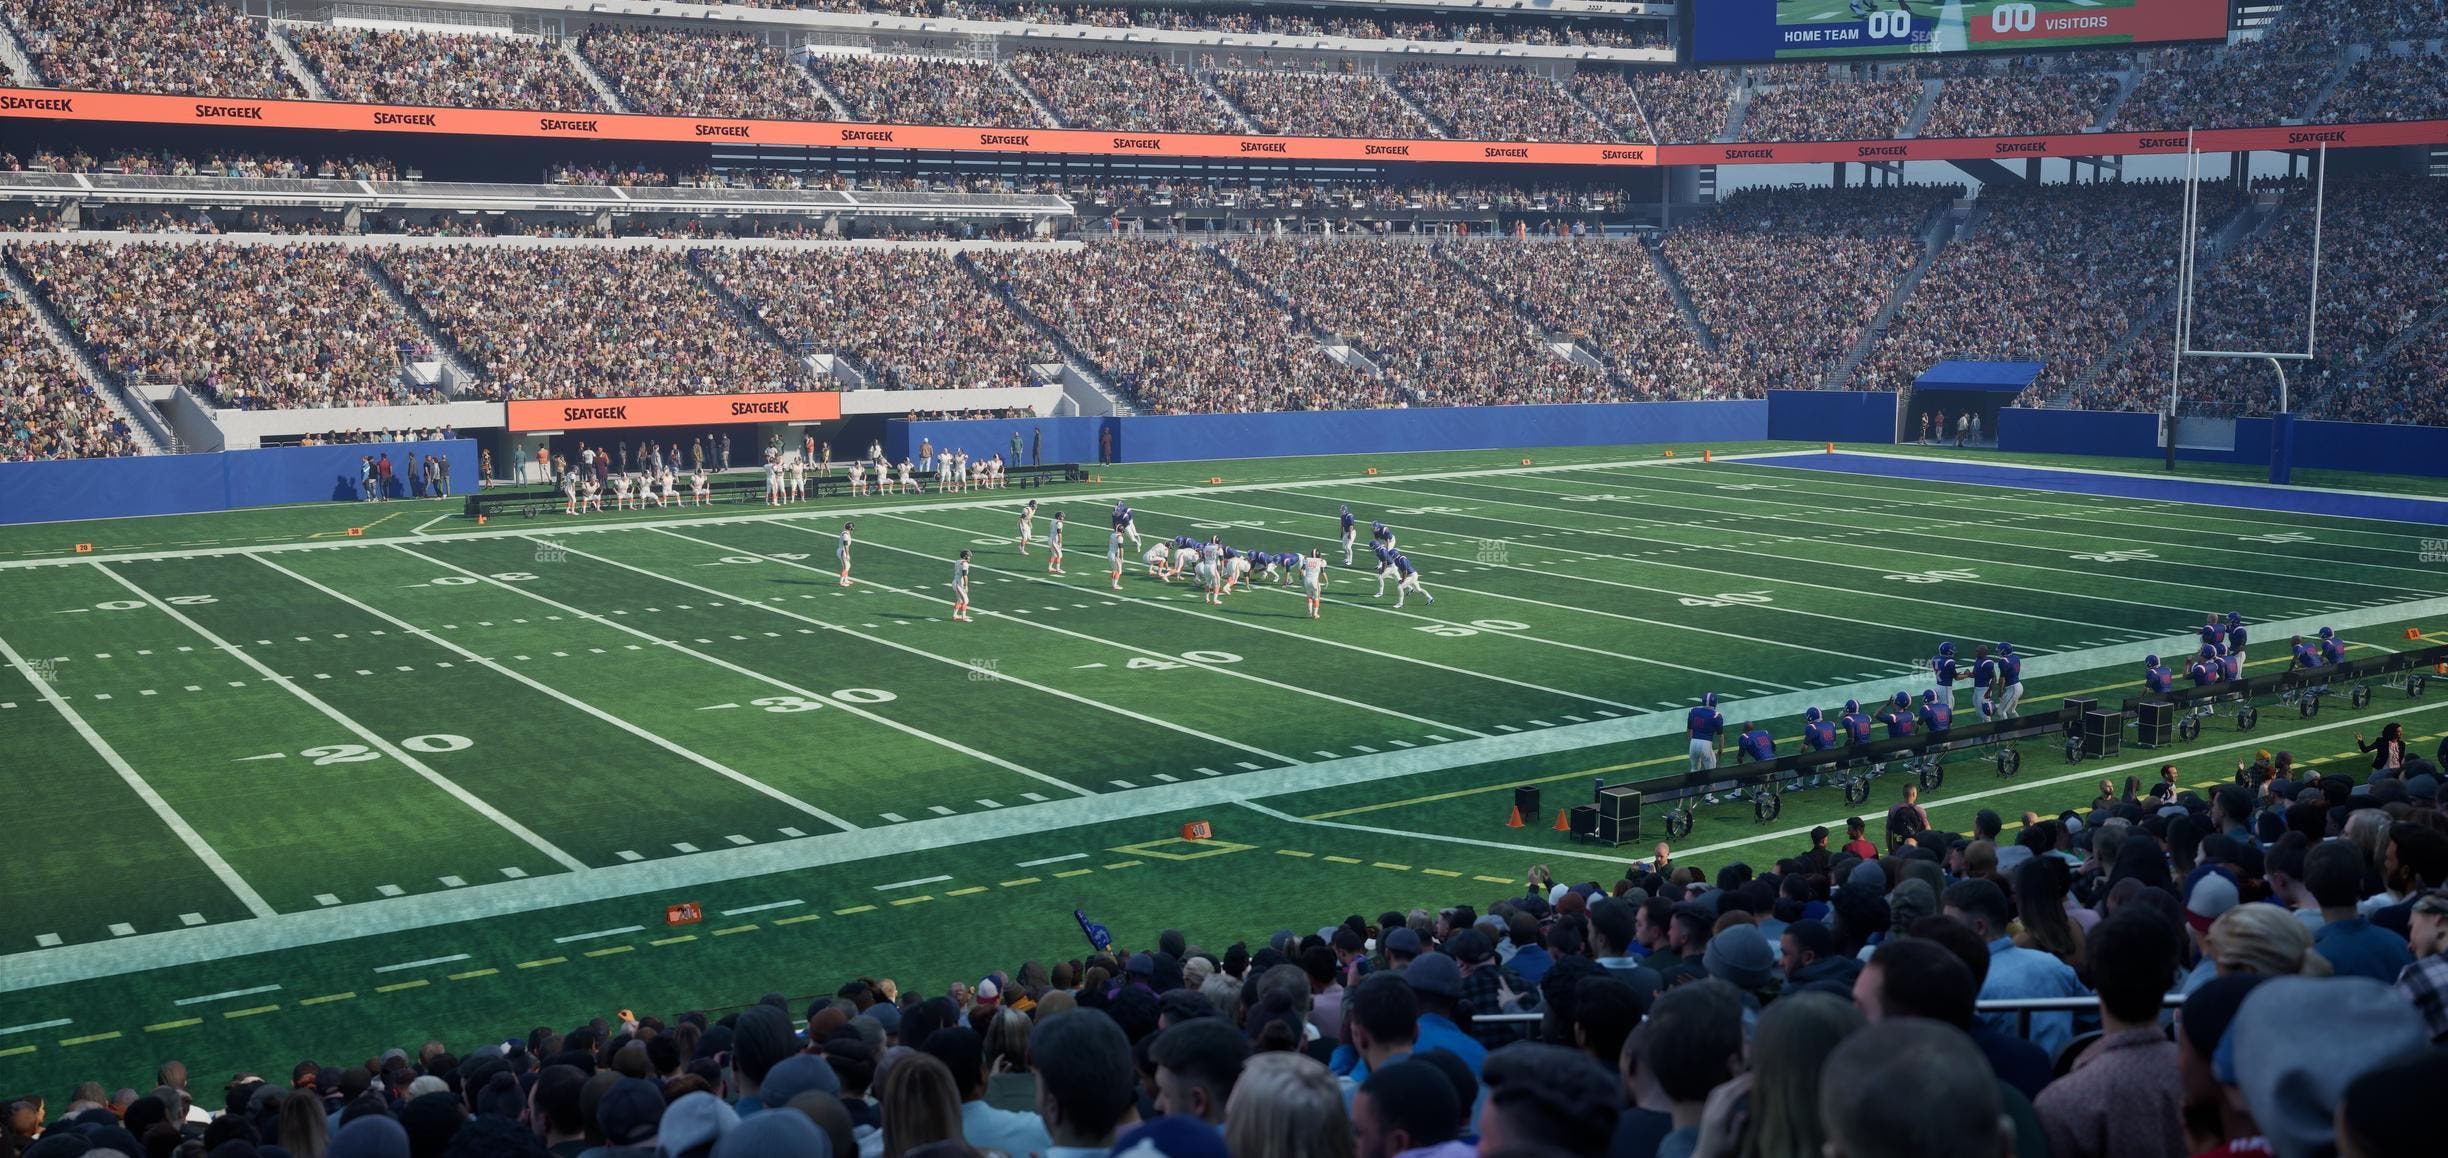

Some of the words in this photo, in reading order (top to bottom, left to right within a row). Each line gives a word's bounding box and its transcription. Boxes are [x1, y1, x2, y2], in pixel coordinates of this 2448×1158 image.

[1868, 10, 1911, 39] 00
[1992, 4, 2037, 33] 00
[2045, 16, 2108, 30] VISITORS
[1784, 30, 1822, 42] HOME
[1825, 28, 1859, 41] TEAM
[0, 96, 73, 112] SEATGEEK
[195, 104, 263, 120] SEATGEEK
[373, 111, 437, 127] SEATGEEK
[540, 118, 598, 133] SEATGEEK
[695, 124, 750, 138] SEATGEEK
[841, 129, 893, 143] SEATGEEK
[980, 134, 1029, 147] SEATGEEK
[2288, 130, 2346, 144] SEATGEEK
[1113, 138, 1161, 150] SEATGEEK
[1240, 141, 1287, 153] SEATGEEK
[1364, 144, 1409, 156] SEATGEEK
[1858, 145, 1907, 157] SEATGEEK
[1995, 141, 2047, 153] SEATGEEK
[1484, 147, 1529, 159] SEATGEEK
[1602, 149, 1644, 161] SEATGEEK
[1725, 148, 1773, 160] SEATGEEK
[563, 405, 627, 422] SEATGEEK
[731, 400, 789, 416] SEATGEEK
[1411, 619, 1531, 637] 50
[1126, 651, 1244, 670] 40
[750, 688, 898, 713] 30
[299, 734, 474, 766] 20
